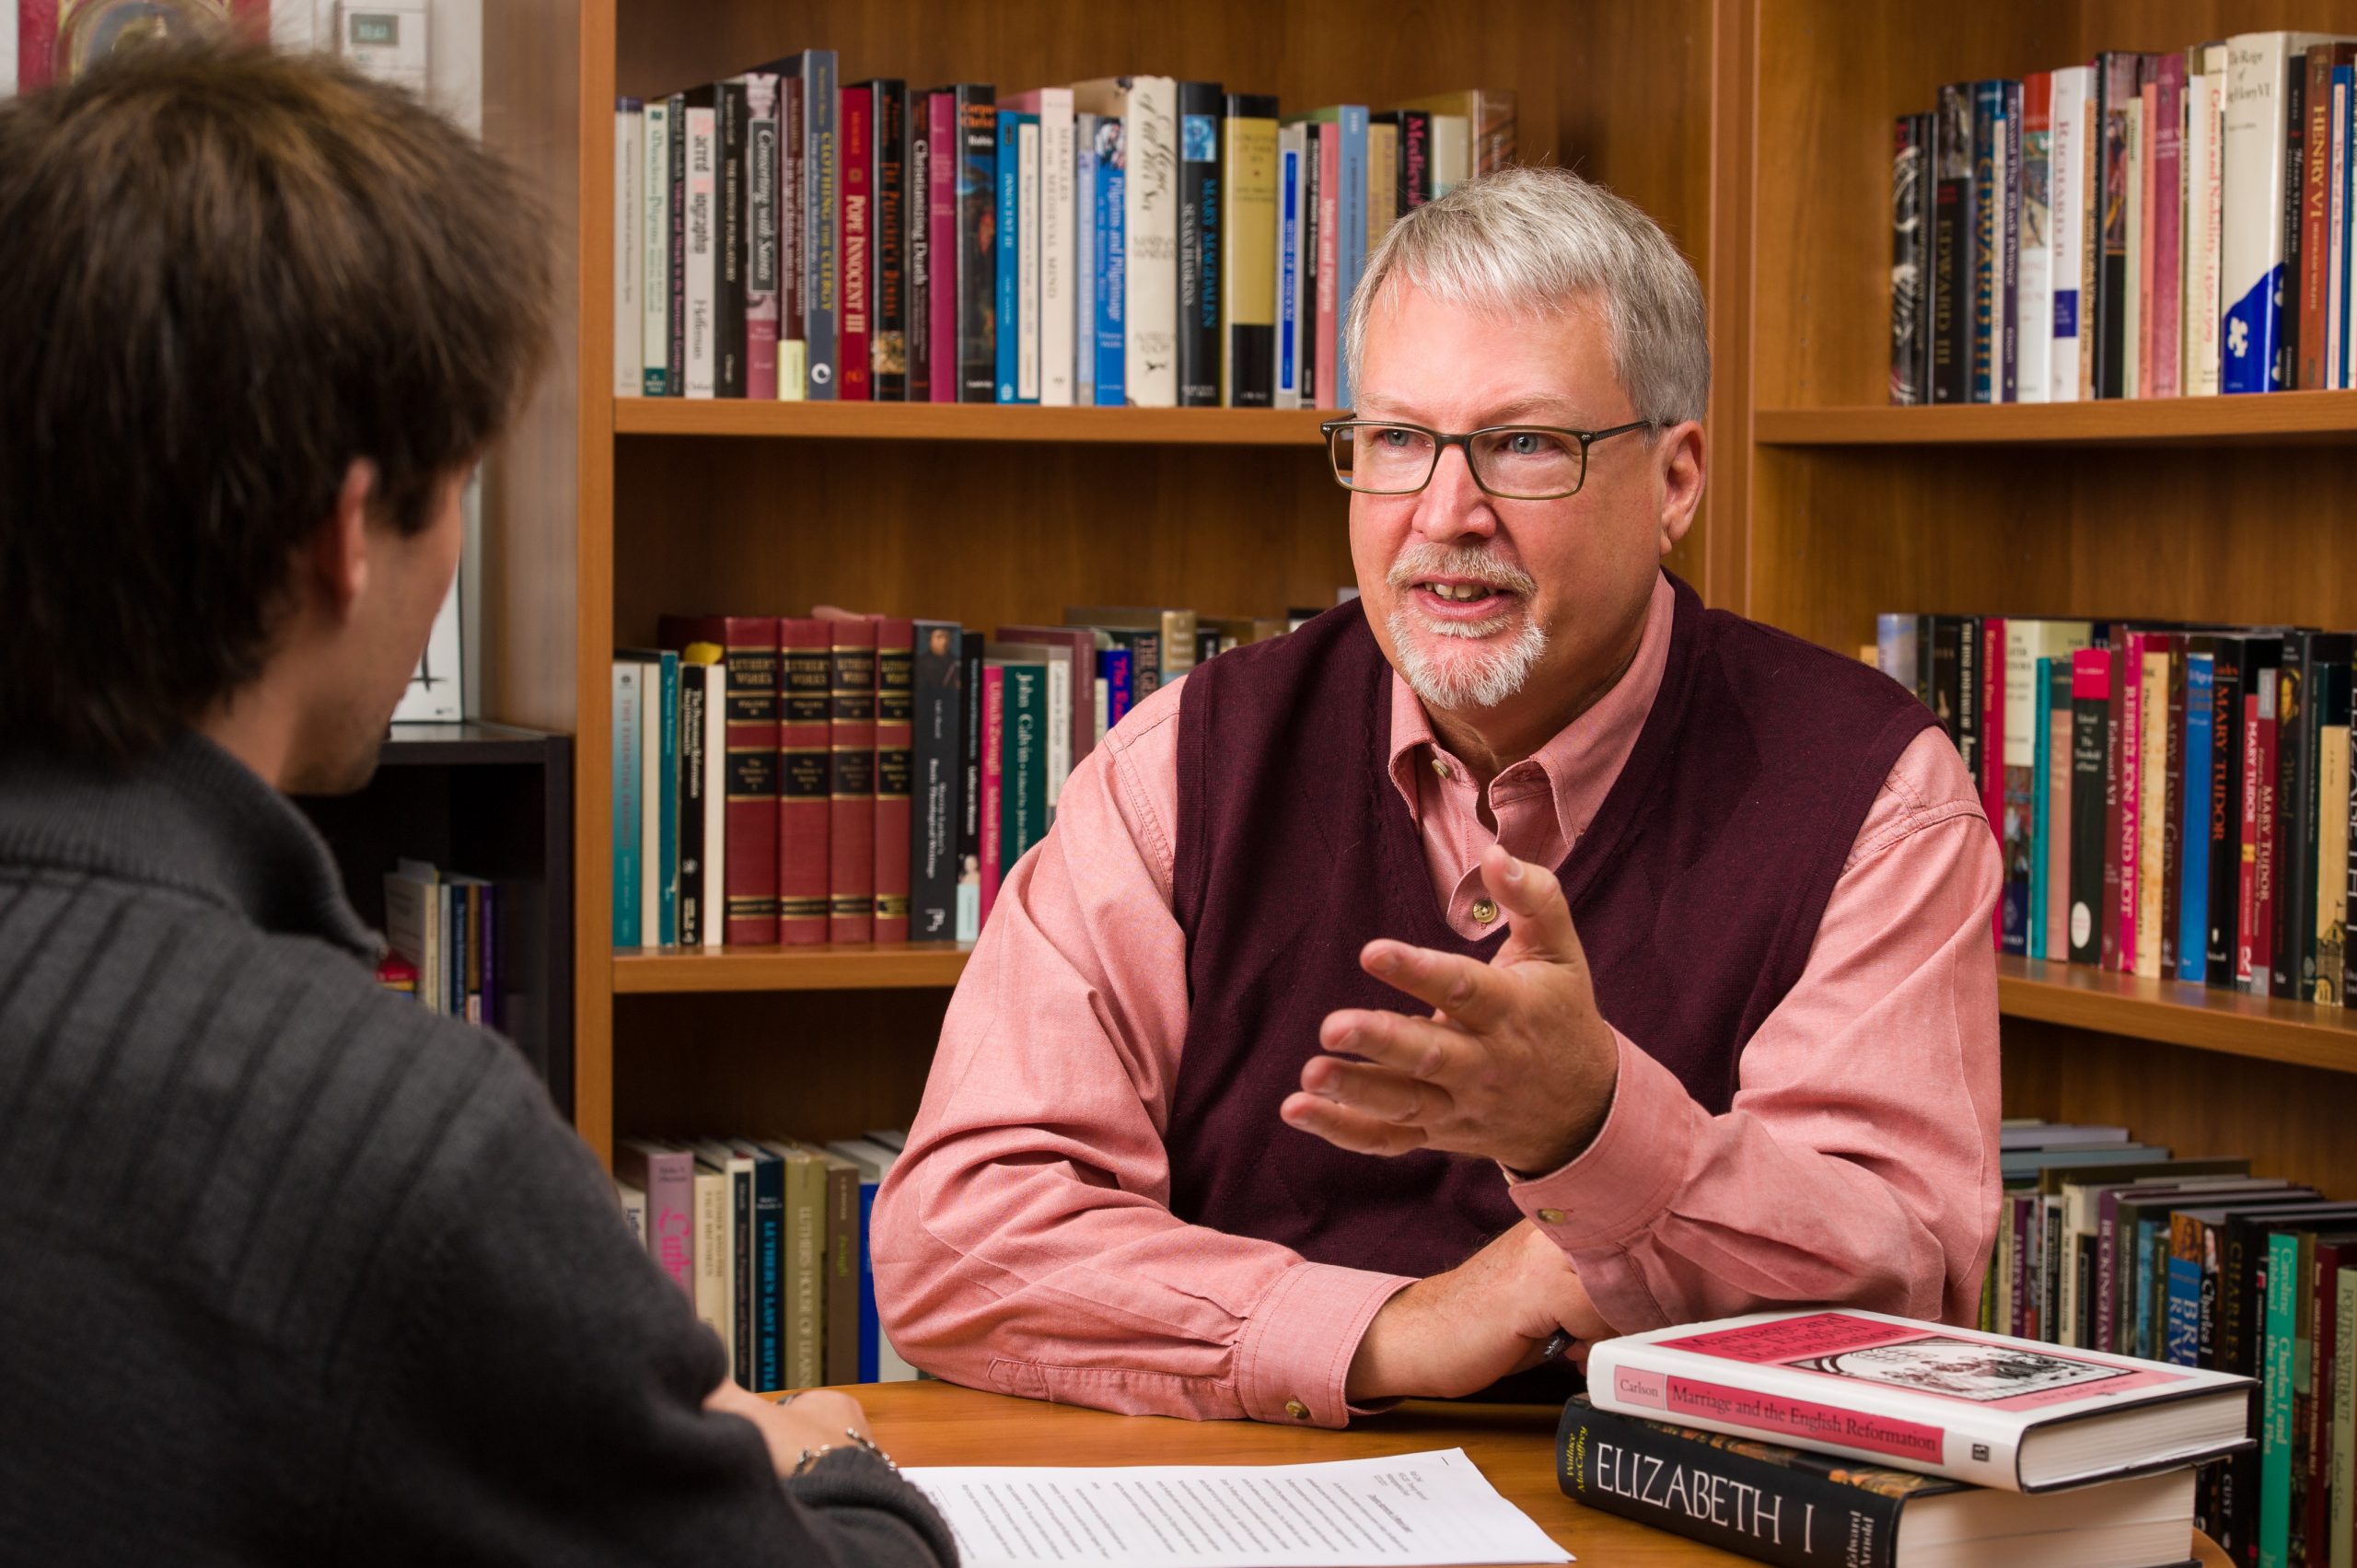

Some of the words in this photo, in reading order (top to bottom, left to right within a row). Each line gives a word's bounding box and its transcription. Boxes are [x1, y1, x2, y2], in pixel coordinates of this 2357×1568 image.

[2004, 97, 2019, 152] Edward
[2208, 87, 2222, 146] Crown
[750, 129, 776, 204] Consorting
[1405, 117, 1425, 207] Medieval
[2208, 149, 2221, 181] and
[2310, 104, 2327, 187] HENRY
[819, 131, 833, 221] CLOTHING
[911, 139, 929, 241] Christianizing
[2004, 157, 2019, 187] The
[2055, 120, 2071, 236] RICHARD
[757, 207, 772, 238] with
[845, 194, 867, 235] POPE
[1046, 173, 1059, 250] MEDIEVAL
[1106, 176, 1125, 227] Pilgrims
[1181, 202, 1195, 247] SUSAN
[1202, 178, 1217, 228] MARY
[1318, 197, 1335, 238] Mystic
[2004, 191, 2019, 235] Black
[2204, 185, 2221, 261] Nobility,
[2310, 190, 2327, 218] VI
[756, 239, 775, 282] Saints
[911, 242, 929, 286] Death
[1108, 230, 1124, 254] and
[1321, 240, 1335, 263] and
[2004, 236, 2019, 288] Prince
[819, 250, 833, 313] CLERGY
[845, 236, 867, 313] INNOCENT
[1046, 256, 1059, 299] MIND
[1106, 256, 1125, 321] Pilgrimage
[1181, 248, 1195, 306] HASKINS
[1202, 231, 1217, 329] MAGDALEN
[1318, 265, 1335, 313] Pilgrim
[1935, 219, 1955, 331] EDWARD
[692, 298, 709, 360] Heffernan
[845, 313, 867, 334] III
[1935, 338, 1955, 366] III
[1112, 656, 1128, 686] The
[1138, 637, 1157, 668] THE
[1015, 672, 1035, 708] John
[1015, 713, 1035, 764] Calvin
[2122, 685, 2138, 803] REBELLION
[2165, 704, 2183, 762] LADY
[2212, 686, 2229, 752] MARY
[2247, 720, 2258, 768] MARY
[2106, 719, 2119, 782] Edward
[2106, 784, 2119, 807] VI
[2165, 771, 2181, 819] JANE
[2212, 759, 2228, 842] TUDOR
[2246, 771, 2257, 823] TUDOR
[2260, 784, 2273, 836] MARY
[985, 827, 998, 865] Works
[2120, 807, 2136, 863] AND
[2163, 821, 2179, 879] GREY
[2119, 865, 2135, 920] RIOT
[2259, 838, 2273, 901] TUDOR
[657, 1207, 692, 1284] Luth
[762, 1220, 777, 1293] LUTHER'S
[2011, 1234, 2024, 1286] JAMES
[798, 1269, 814, 1313] HOUSE
[2225, 1240, 2243, 1363] CHARLES
[2267, 1246, 2280, 1311] Hibbard
[2278, 1248, 2294, 1317] Caroline
[762, 1295, 777, 1332] LAST
[798, 1318, 814, 1338] OF
[1682, 1323, 1793, 1347] Marriage
[1797, 1316, 1852, 1329] and
[2200, 1278, 2215, 1344] Charles
[2340, 1287, 2355, 1353] POLITICS
[762, 1336, 777, 1391] BATTLE
[798, 1340, 814, 1389] LEARN
[1718, 1340, 1767, 1353] the
[1771, 1325, 1867, 1345] English
[1739, 1329, 1910, 1358] Reformation
[2200, 1345, 2215, 1355] I
[2265, 1334, 2278, 1361] the
[1619, 1377, 1658, 1399] Carlson
[2262, 1365, 2277, 1419] Popish
[2278, 1336, 2291, 1398] Charles
[2338, 1355, 2353, 1426] WITHOUT
[1672, 1383, 1729, 1414] Marriage
[1735, 1394, 1760, 1417] and
[1763, 1400, 1785, 1423] the
[1789, 1407, 1841, 1434] English
[1845, 1416, 1936, 1452] Reformation
[2276, 1413, 2289, 1446] and
[2278, 1402, 2291, 1411] I
[1566, 1433, 1577, 1477] Wallace
[1575, 1425, 1588, 1493] MacCaffrey
[2263, 1423, 2275, 1455] Plot
[1597, 1442, 1782, 1545] ELIZABETH
[1804, 1504, 1814, 1554] I
[2223, 1472, 2234, 1518] CUST
[1845, 1510, 1862, 1568] Edward
